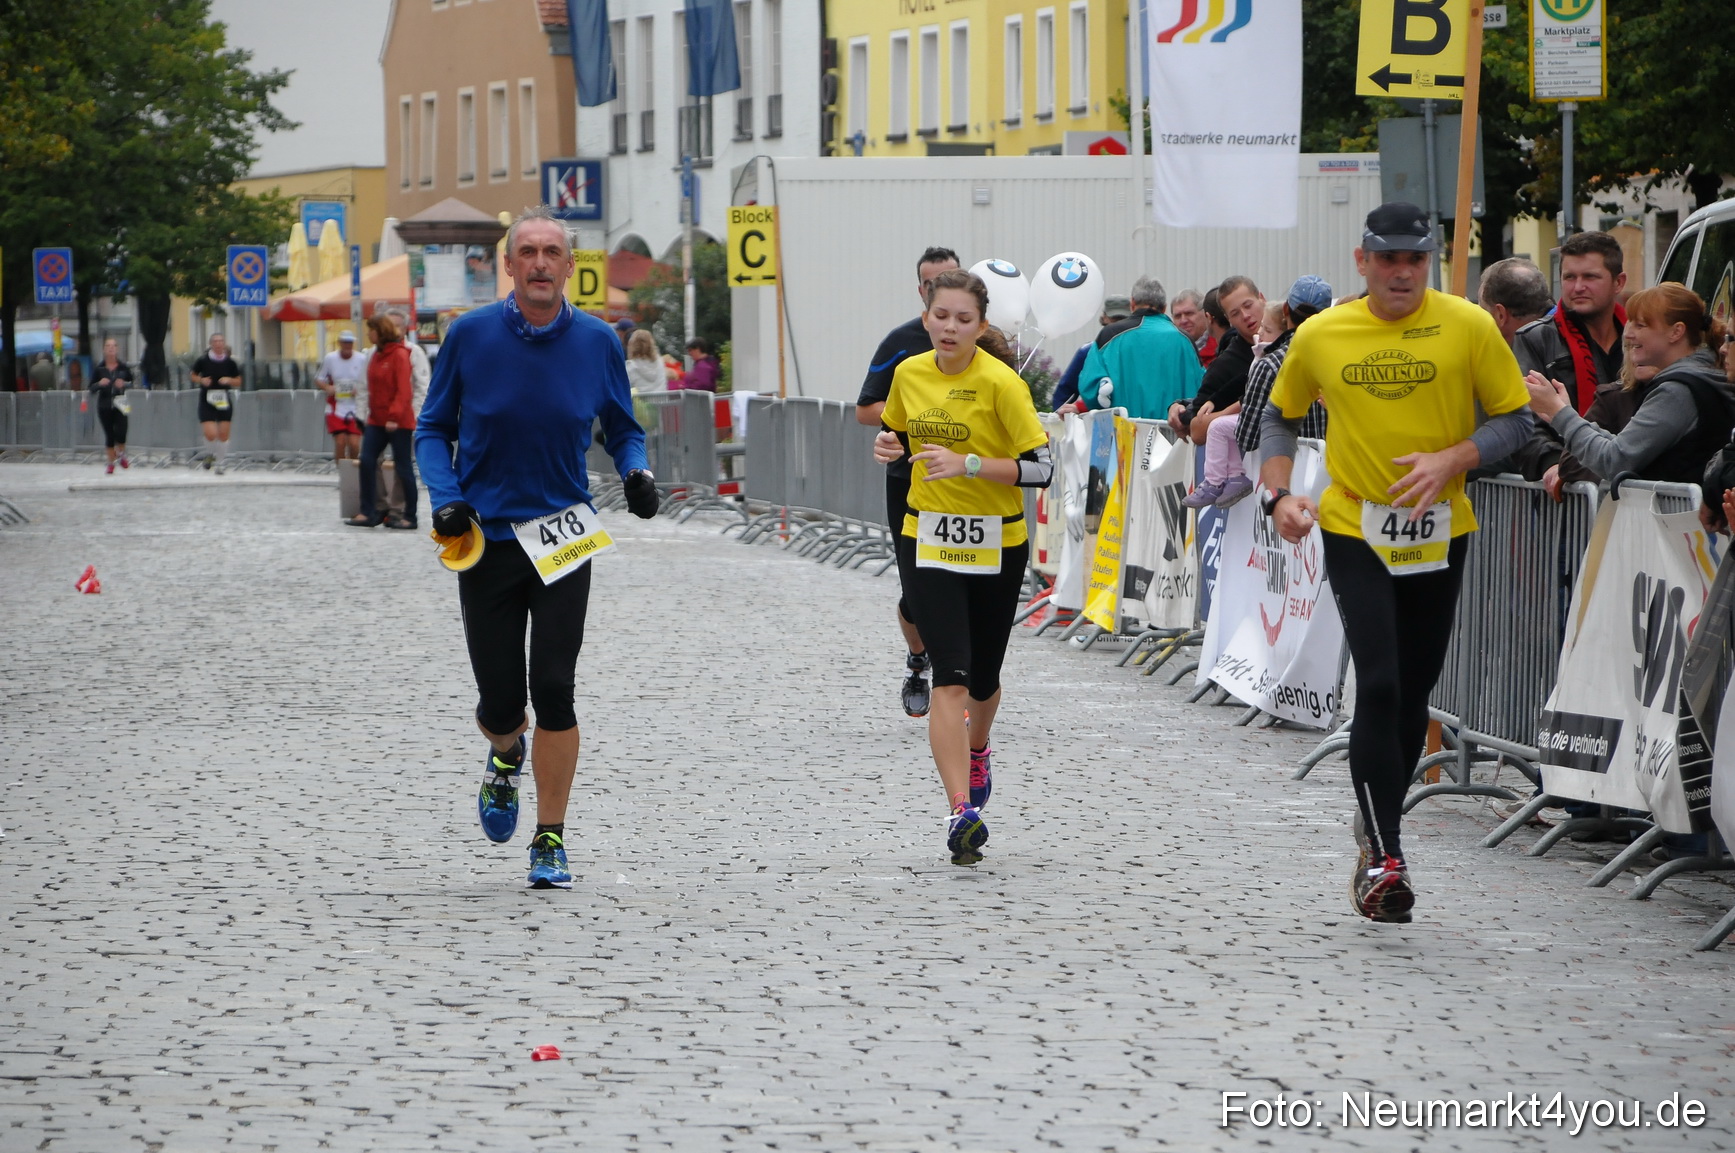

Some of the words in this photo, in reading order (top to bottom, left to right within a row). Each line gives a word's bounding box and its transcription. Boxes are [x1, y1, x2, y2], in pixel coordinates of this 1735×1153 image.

[1391, 0, 1451, 55] B
[1544, 26, 1591, 36] Marktplatz
[1161, 132, 1223, 144] stadtwerke
[1227, 133, 1298, 145] neumarkt
[732, 209, 774, 224] Block
[573, 251, 604, 262] Block
[740, 229, 767, 269] C
[578, 267, 598, 296] D
[39, 286, 69, 299] TAXI
[231, 287, 265, 302] TAXI
[1364, 351, 1414, 365] PIZZERIA
[1353, 364, 1425, 381] FRANCESCO
[911, 422, 960, 438] FRANCESCO
[538, 510, 586, 546] 478
[934, 516, 985, 544] 435
[1381, 510, 1436, 541] 446
[552, 539, 597, 566] Siegfried
[940, 550, 976, 562] Denise
[1390, 550, 1422, 563] Bruno
[1550, 730, 1569, 751] die
[1569, 734, 1609, 756] verbinden
